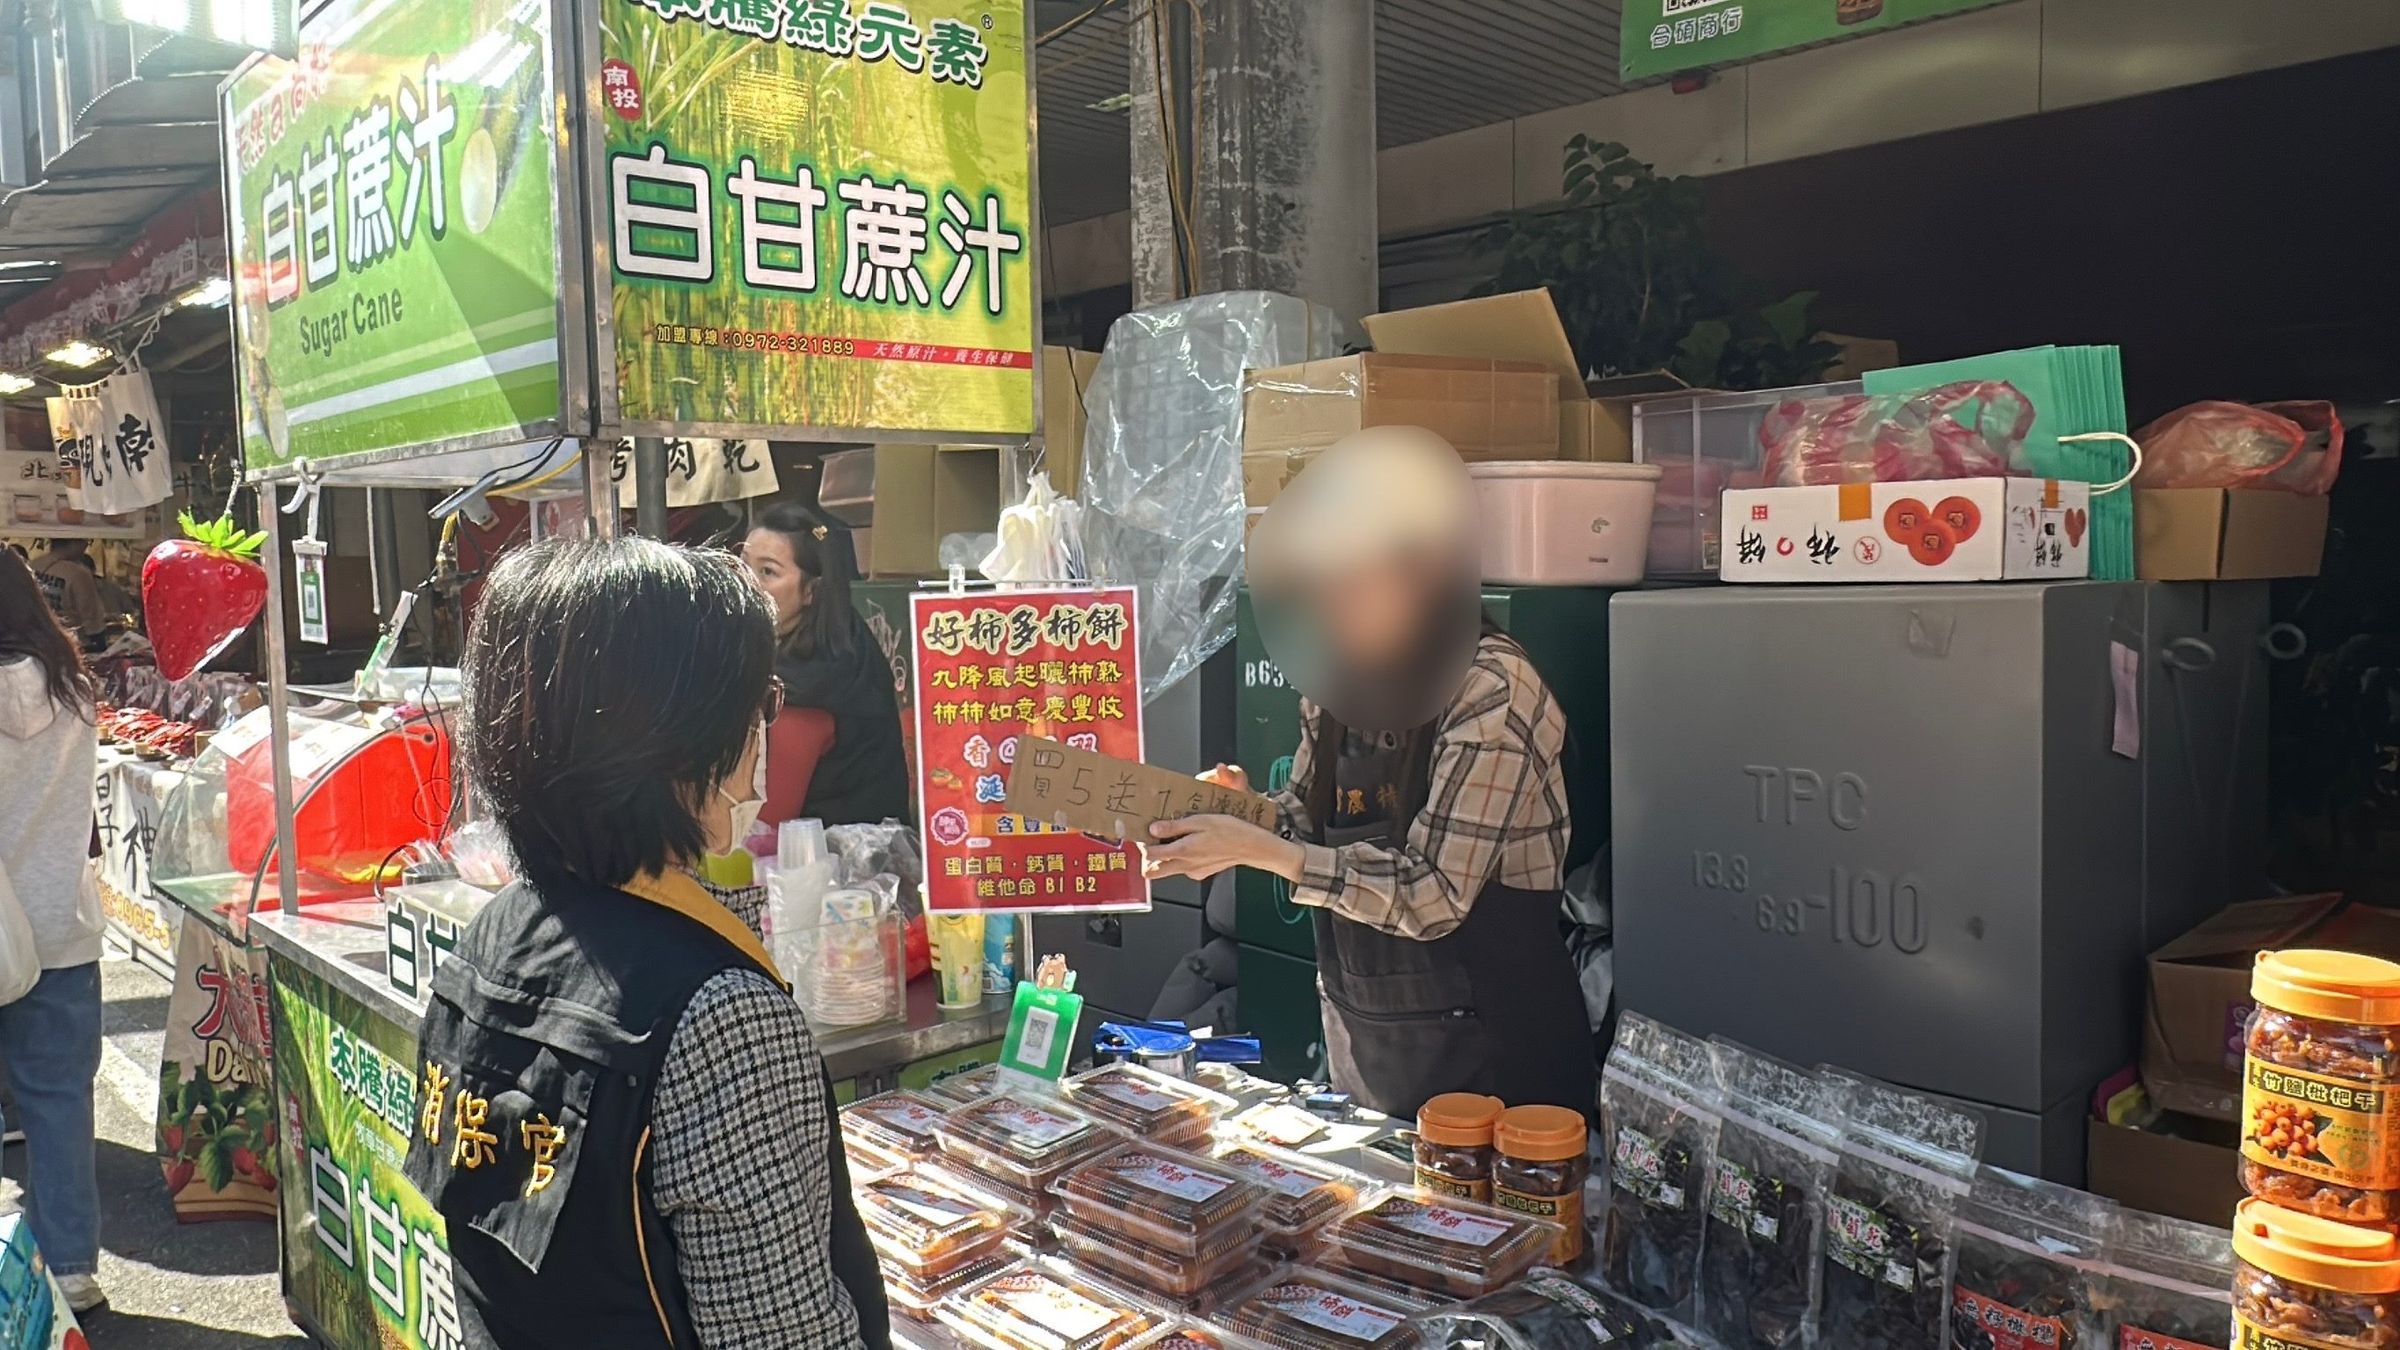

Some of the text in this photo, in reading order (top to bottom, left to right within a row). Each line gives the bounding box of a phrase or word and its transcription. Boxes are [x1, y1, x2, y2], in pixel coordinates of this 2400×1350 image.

[603, 65, 640, 109] 南投
[260, 53, 457, 310] 白甘蔗汁
[611, 142, 1021, 315] 白甘蔗汁
[299, 287, 404, 357] Sugar Cane
[922, 603, 1128, 656] 好柿多柿餅
[931, 659, 1124, 690] 九降風起曬柿熟
[932, 692, 1126, 725] 柿柿如意慶豐收
[1743, 764, 1868, 831] TPC
[977, 876, 1097, 897] 維他命 B1 B2
[421, 1059, 567, 1199] 消保官
